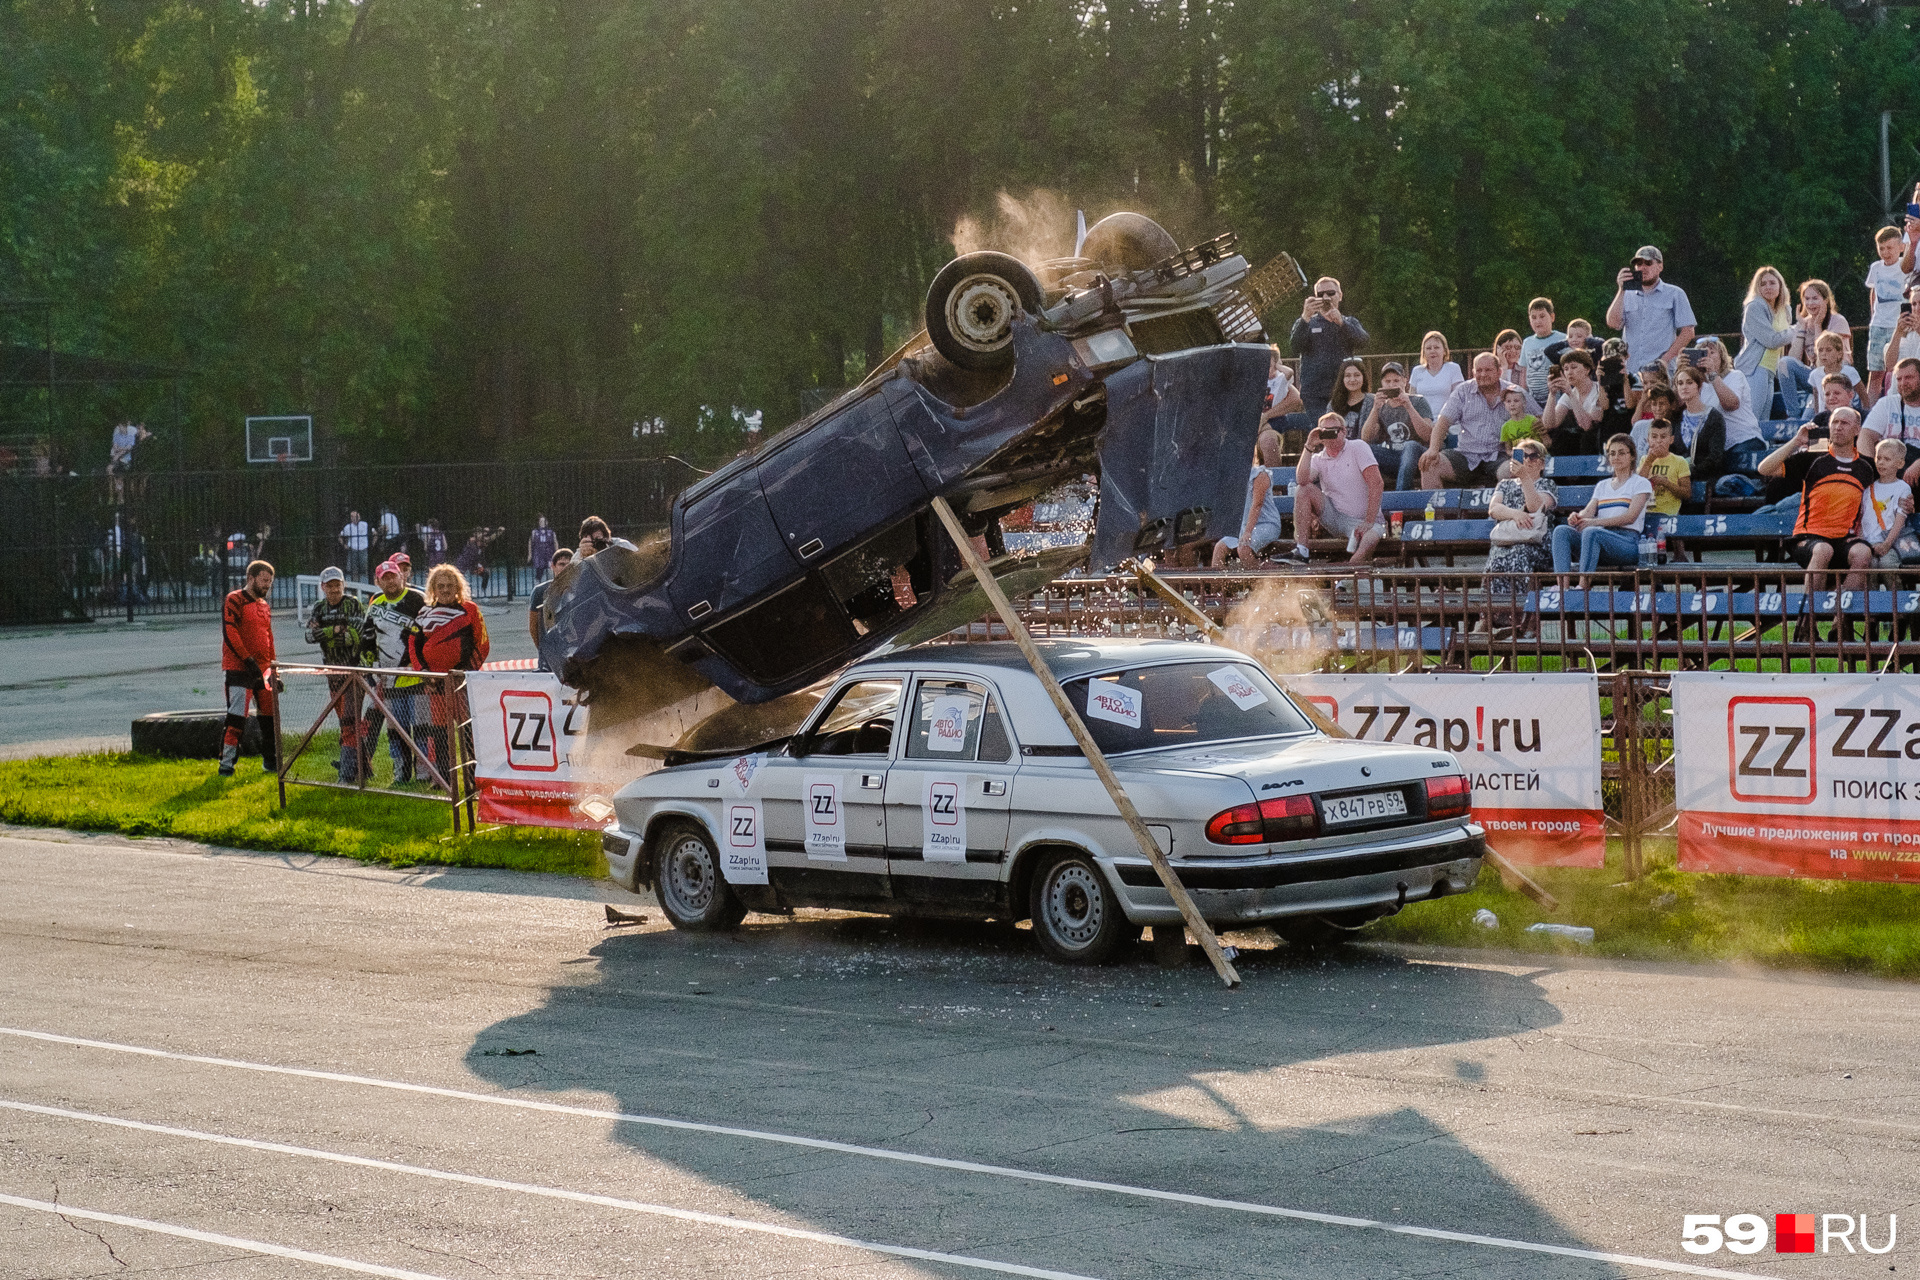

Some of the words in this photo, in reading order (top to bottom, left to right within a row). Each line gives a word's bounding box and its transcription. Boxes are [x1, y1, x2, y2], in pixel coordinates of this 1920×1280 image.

[1430, 492, 1446, 508] 45
[1470, 490, 1494, 507] 36
[1411, 524, 1433, 540] 65
[1703, 515, 1728, 536] 55
[434, 540, 442, 551] 3
[1822, 591, 1854, 610] 36
[1093, 695, 1122, 707] АВТО
[1101, 703, 1137, 718] РАДИО
[509, 712, 551, 752] ZZ
[933, 719, 954, 729] АВТО
[1353, 705, 1542, 754] ZZap!ru
[938, 729, 963, 739] РАДИО
[1738, 725, 1807, 778] ZZ
[491, 785, 525, 797] Лучшие
[1833, 780, 1907, 801] ПОИСК
[813, 795, 834, 814] ZZ
[933, 794, 955, 814] ZZ
[1386, 792, 1400, 808] 59
[732, 817, 754, 837] ZZ
[1486, 820, 1527, 831] твоем
[1532, 821, 1581, 833] городе
[1701, 822, 1756, 838] Лучшие
[1759, 826, 1858, 842] предложения
[1862, 832, 1879, 842] от
[931, 833, 961, 845] ZZap!ru
[729, 854, 760, 867] ZZap!ru
[1829, 848, 1848, 860] на
